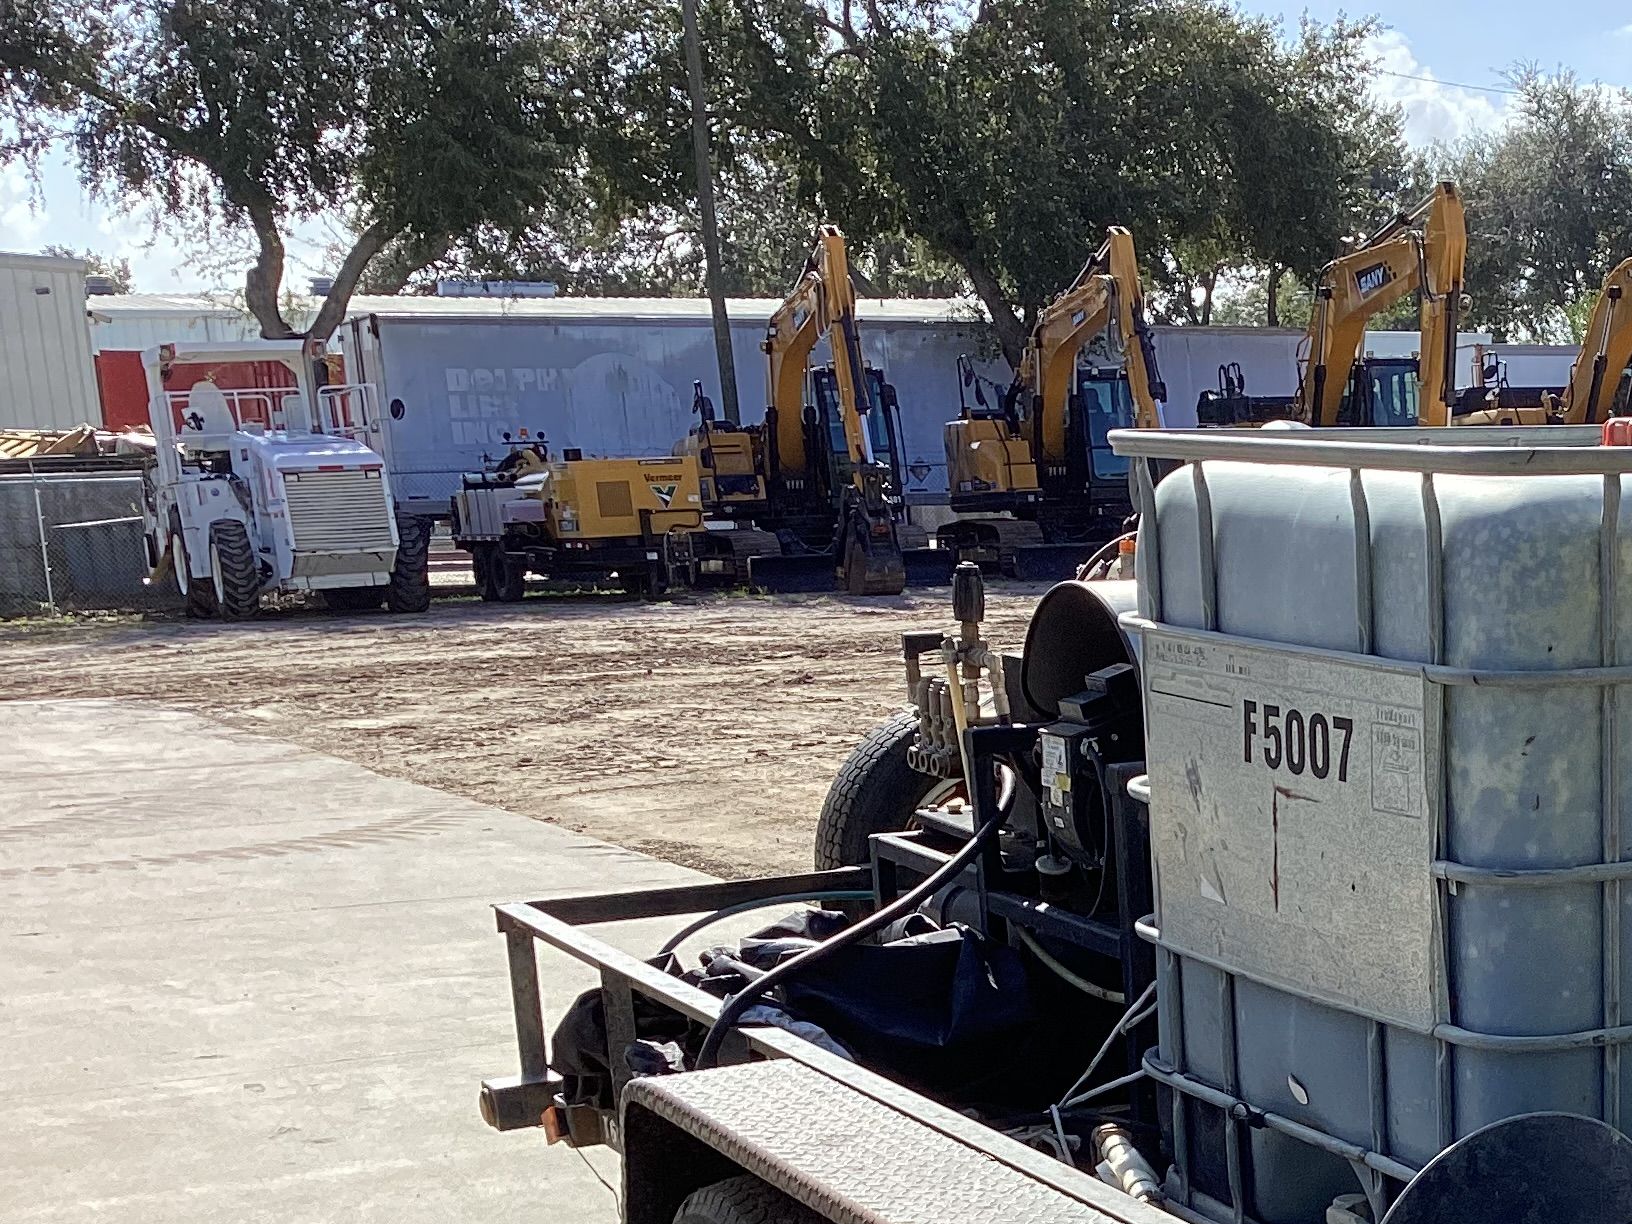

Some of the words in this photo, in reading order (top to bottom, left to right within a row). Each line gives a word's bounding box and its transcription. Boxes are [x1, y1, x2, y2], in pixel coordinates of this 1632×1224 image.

[1360, 266, 1384, 293] SANY
[643, 473, 683, 482] Vermeer
[1243, 698, 1354, 783] F5007
